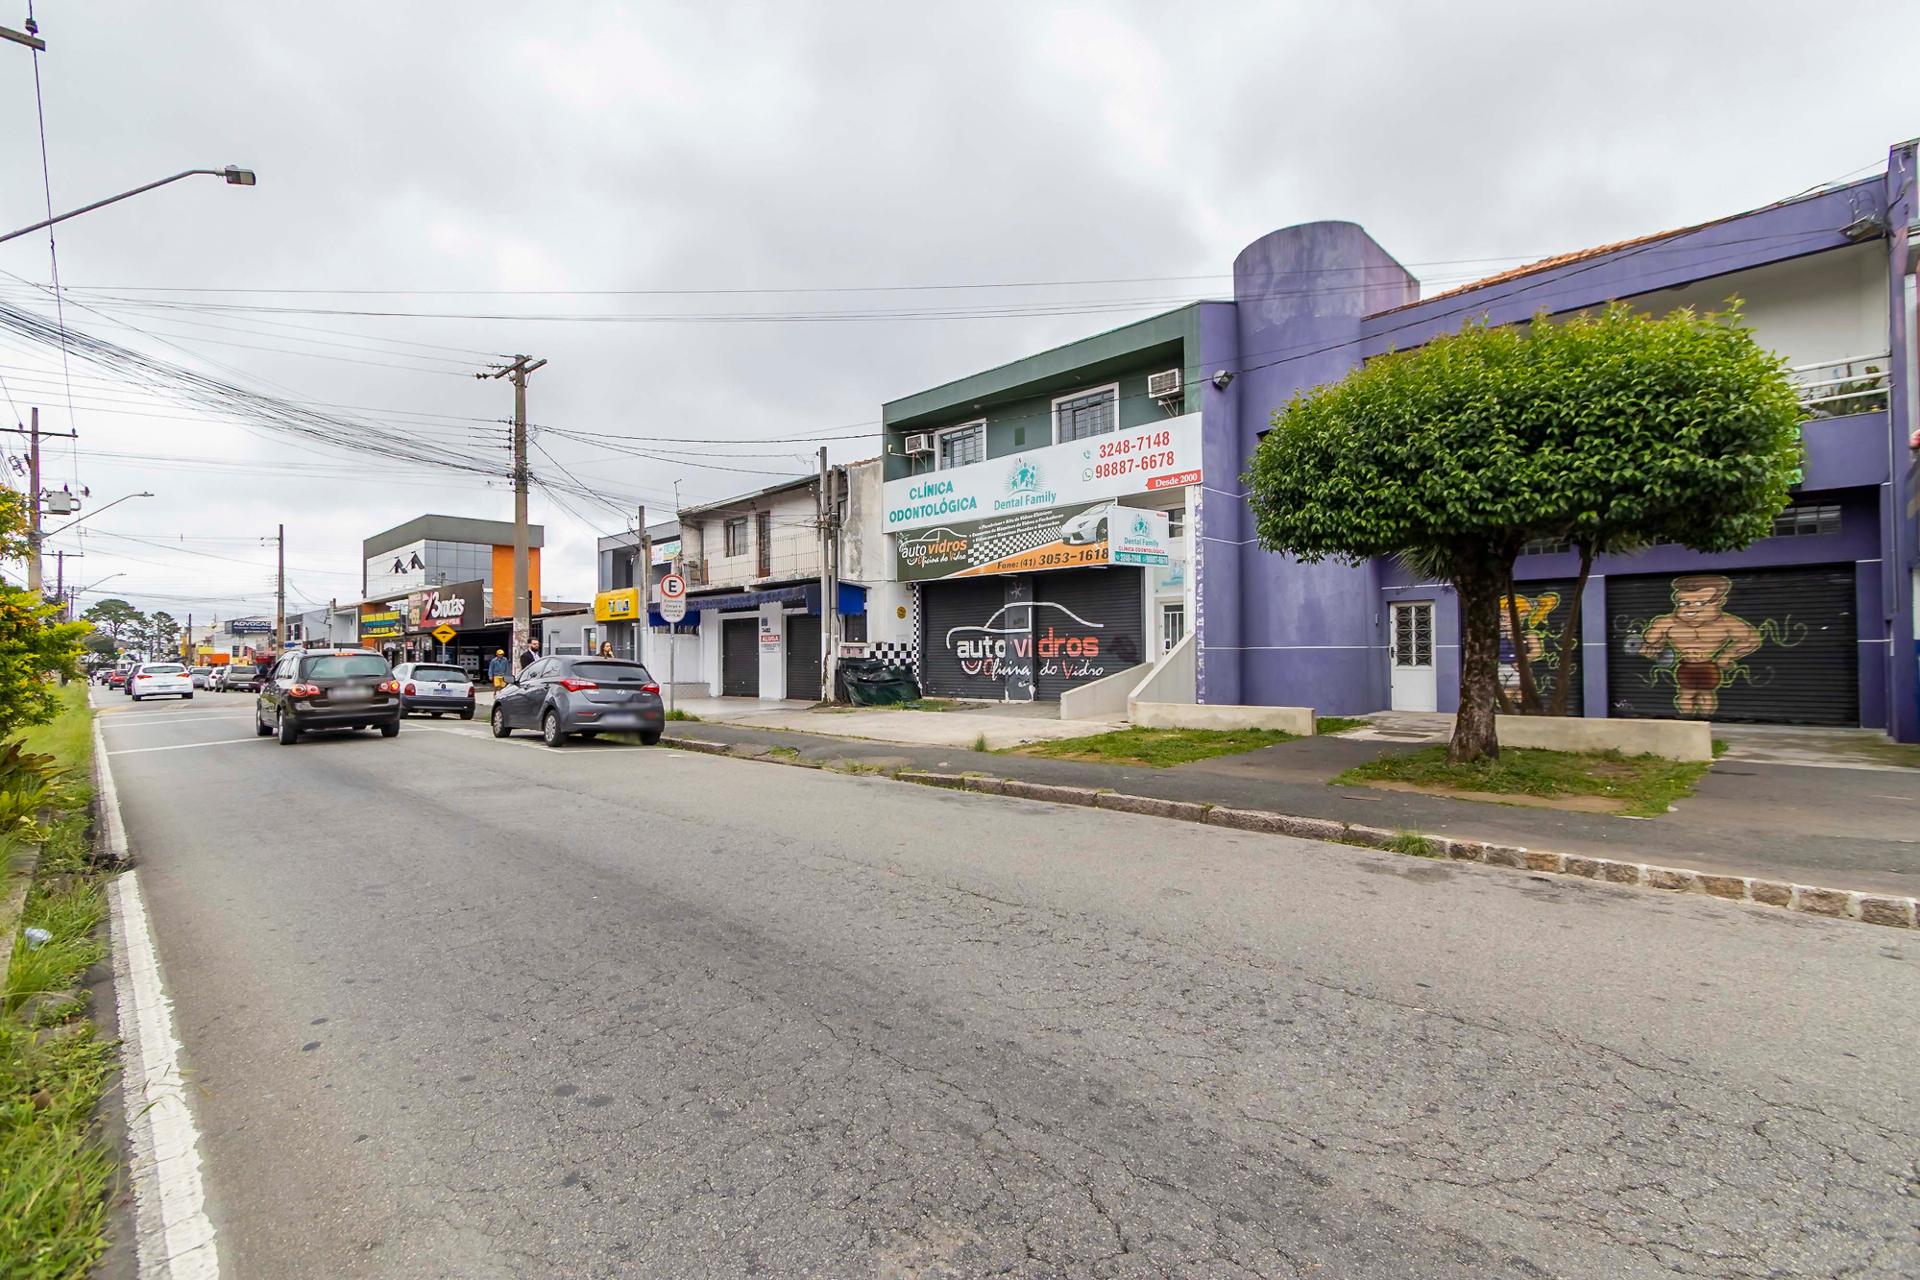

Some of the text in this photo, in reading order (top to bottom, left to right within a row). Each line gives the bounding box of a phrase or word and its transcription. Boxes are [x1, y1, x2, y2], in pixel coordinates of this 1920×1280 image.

[1099, 431, 1170, 459] 3248-7148
[1095, 451, 1175, 479] 98887-6678
[909, 480, 954, 500] CLÍNICA
[1155, 473, 1198, 487] Desde 2000
[889, 495, 978, 523] ODONTOLÓGICA
[994, 490, 1057, 511] Dental Family
[901, 538, 968, 558] auto vidros
[1020, 558, 1036, 568] (41)
[1039, 548, 1108, 565] 3053-1618
[669, 580, 677, 592] E
[957, 627, 1099, 659] auto vidros
[1039, 659, 1058, 676] do
[1063, 659, 1104, 680] Vidro
